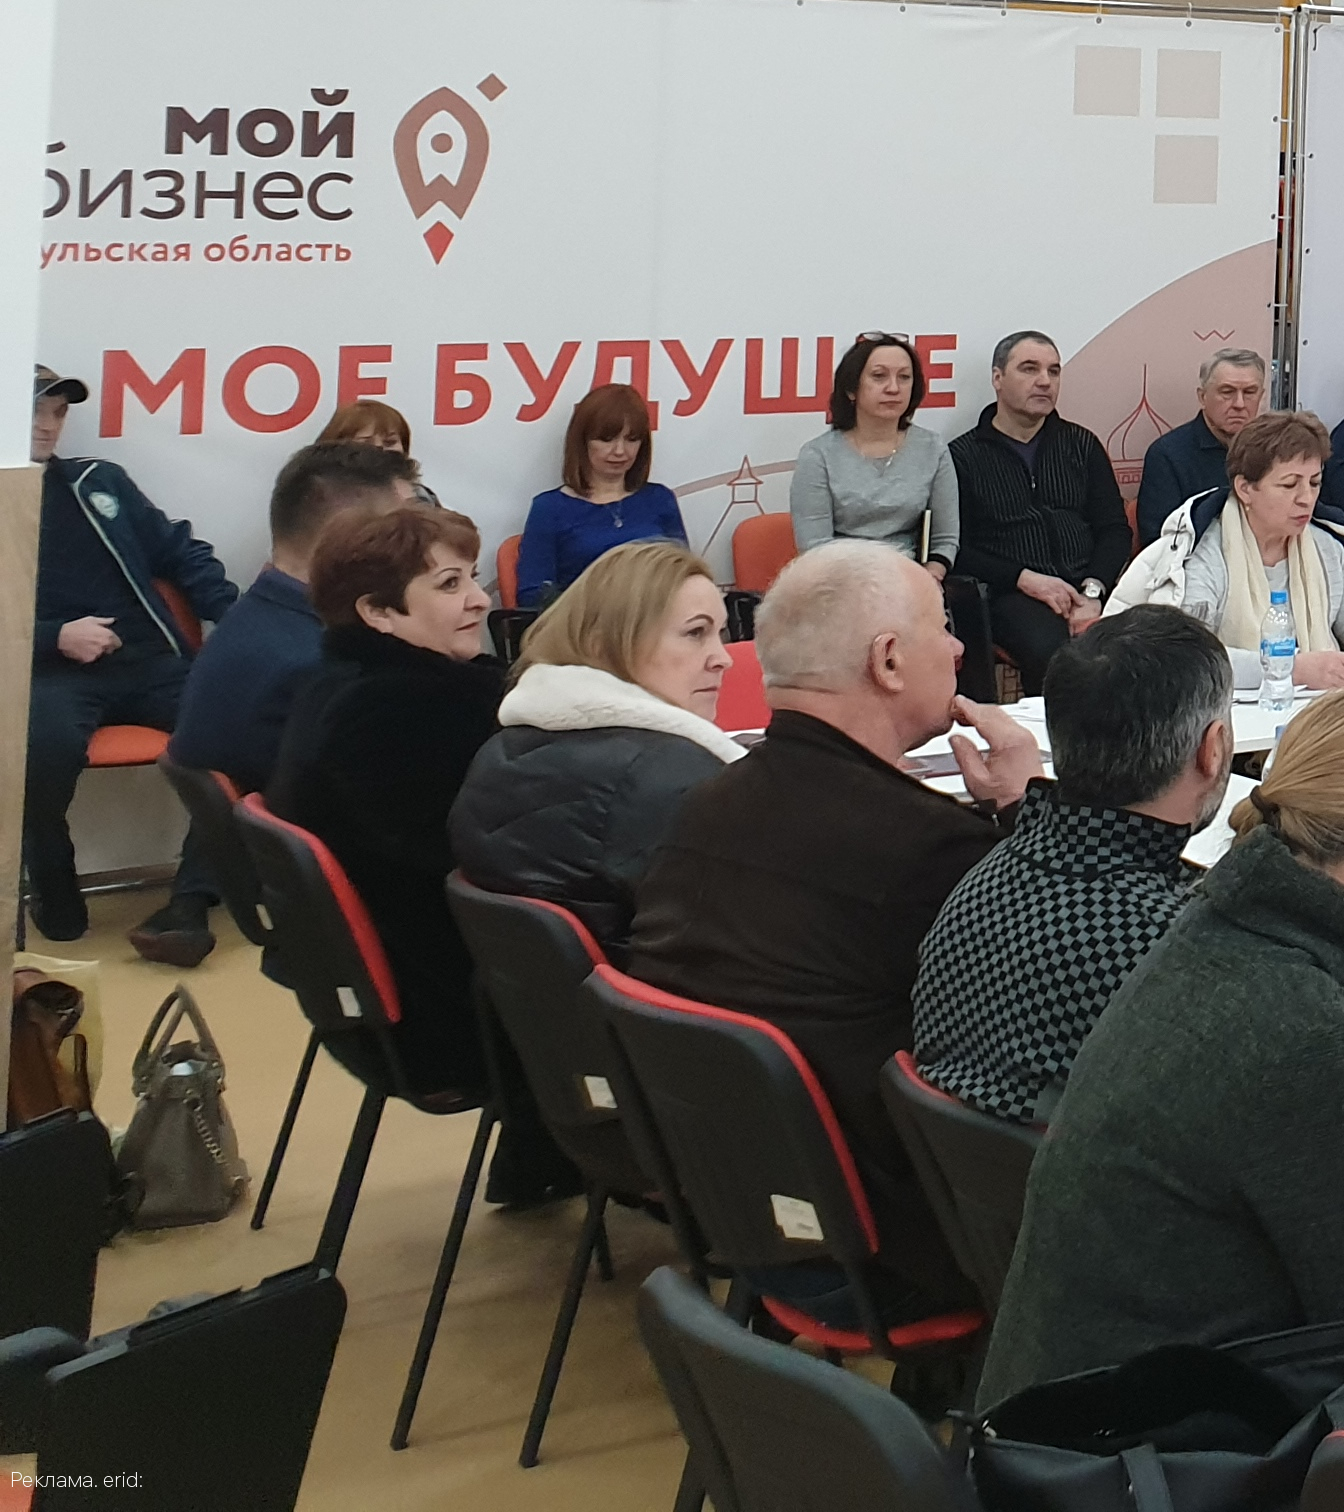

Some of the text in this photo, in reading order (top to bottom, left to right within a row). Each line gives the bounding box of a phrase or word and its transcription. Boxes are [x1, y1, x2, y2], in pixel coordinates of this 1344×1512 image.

[40, 234, 353, 270] ульская область
[98, 334, 957, 438] МОЕ БУДУЩЕ
